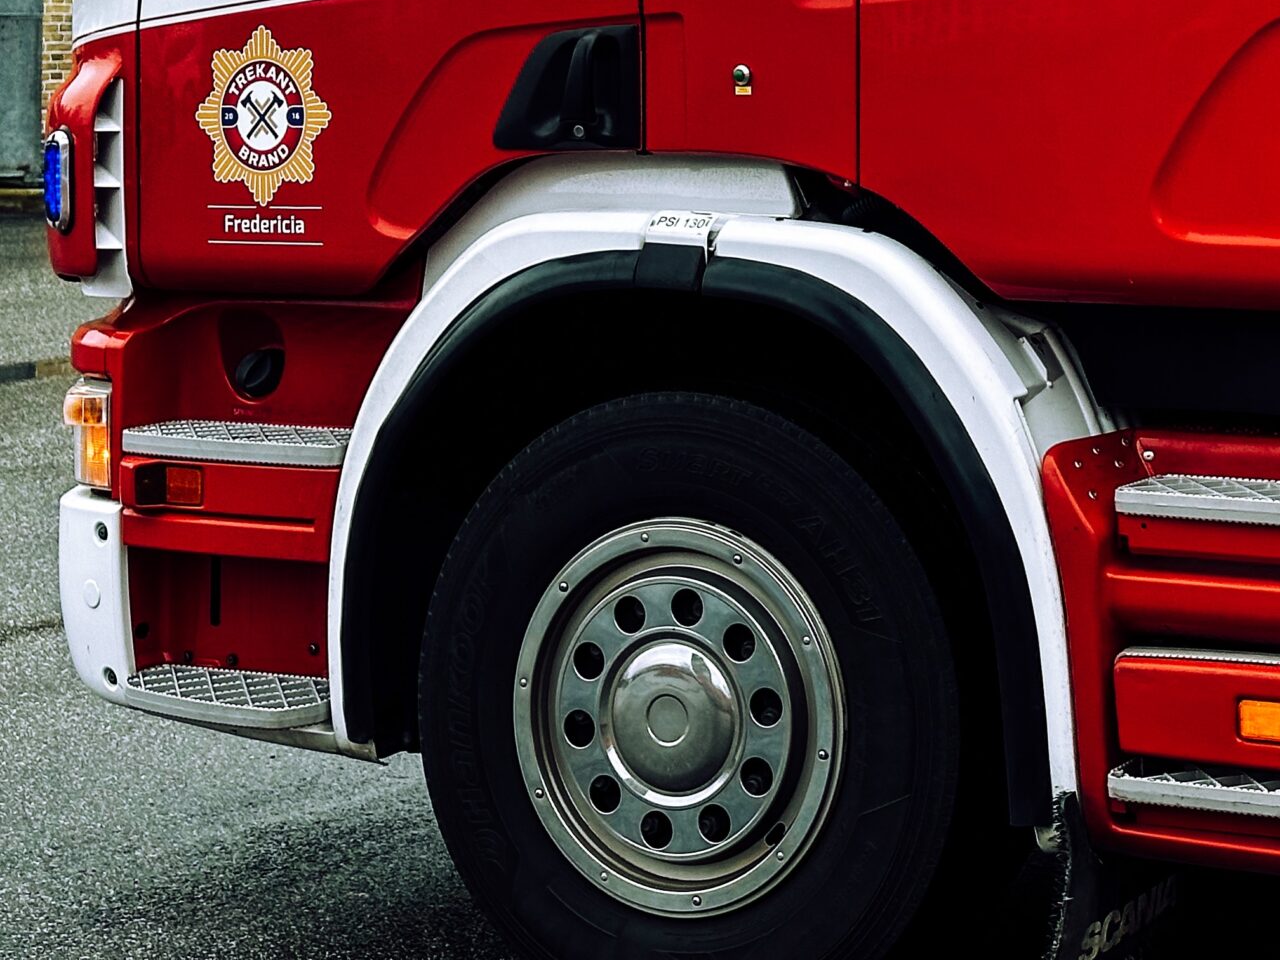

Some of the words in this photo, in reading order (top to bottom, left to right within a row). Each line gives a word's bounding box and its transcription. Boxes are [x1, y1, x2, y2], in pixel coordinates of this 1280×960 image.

[228, 63, 297, 97] TREKANT
[224, 112, 234, 120] 20
[238, 143, 289, 168] BRAND
[224, 213, 305, 234] Fredericia
[656, 216, 680, 227] PSI
